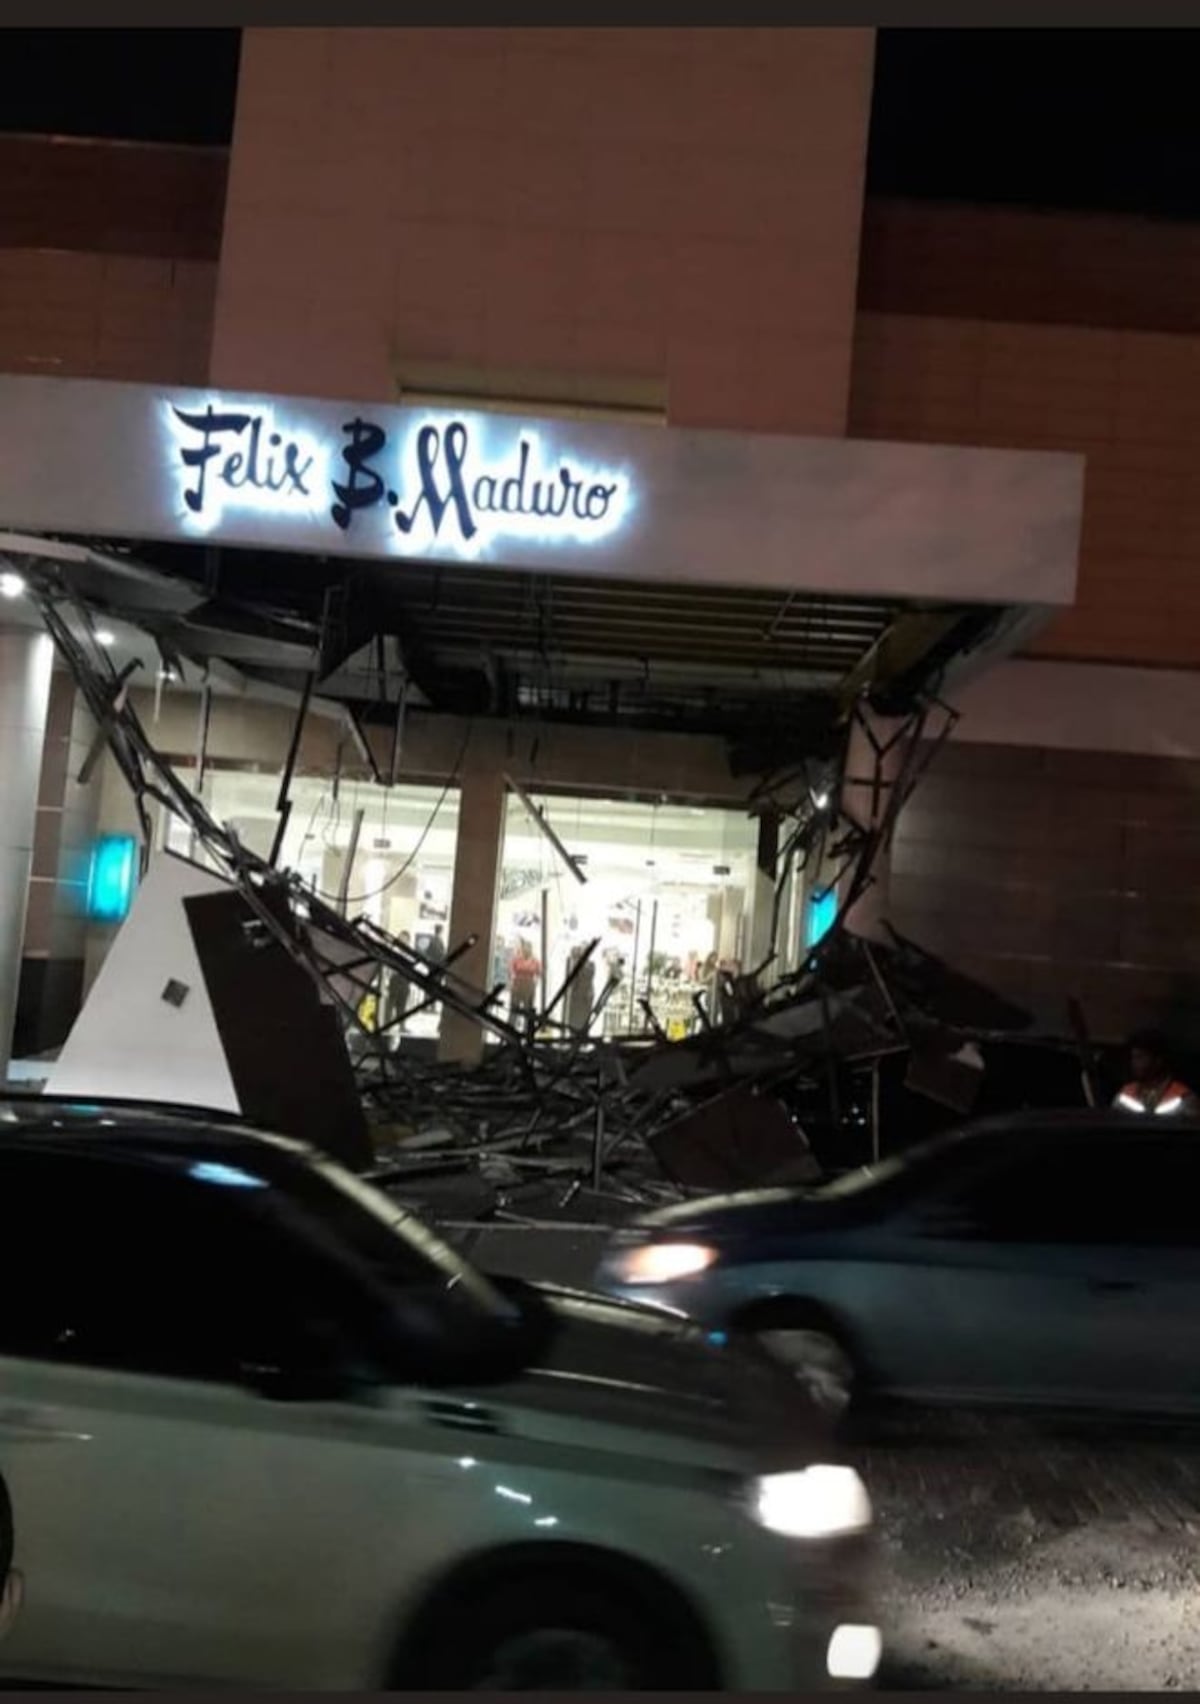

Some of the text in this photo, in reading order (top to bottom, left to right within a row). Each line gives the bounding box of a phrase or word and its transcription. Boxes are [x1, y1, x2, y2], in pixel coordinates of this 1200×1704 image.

[172, 404, 617, 540] Felix B. Maduro
